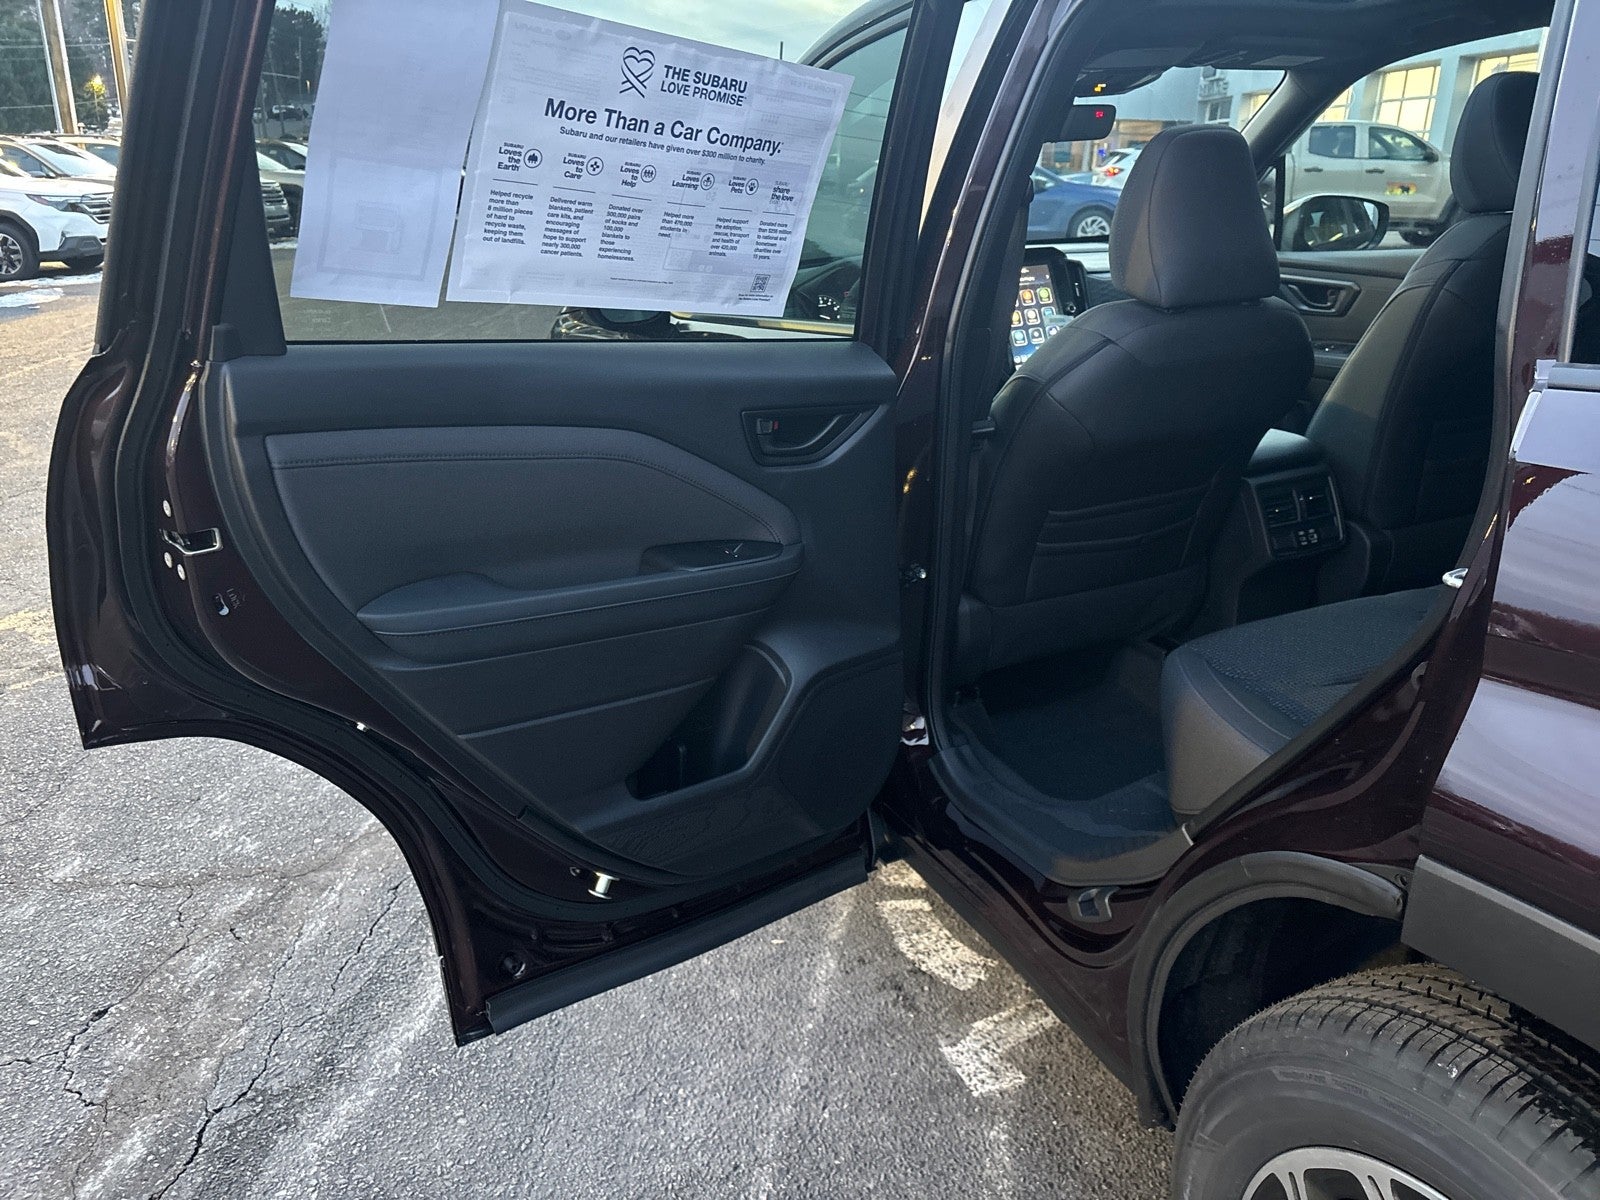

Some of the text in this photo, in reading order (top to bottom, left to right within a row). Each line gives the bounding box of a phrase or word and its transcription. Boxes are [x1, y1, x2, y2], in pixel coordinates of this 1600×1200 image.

[664, 65, 748, 94] THE SUBARU
[660, 80, 690, 97] LOVE
[544, 98, 597, 124] More
[604, 108, 649, 134] Than
[654, 121, 665, 135] a
[670, 120, 701, 142] Car
[559, 126, 588, 140] Subaru
[589, 131, 603, 141] and
[605, 135, 618, 143] our
[619, 136, 647, 148] retailers
[648, 141, 665, 151] have
[666, 144, 685, 154] given
[686, 148, 701, 157] over
[702, 149, 717, 159] $300
[718, 152, 737, 161] million
[745, 155, 766, 165] charity.
[499, 147, 522, 157] Loves
[497, 162, 520, 171] Earth
[563, 157, 585, 167] Loves
[575, 166, 583, 174] to
[620, 166, 640, 175] Loves
[564, 171, 582, 180] Care
[682, 174, 700, 183] Loves
[621, 179, 637, 188] Help
[672, 180, 698, 191] Learning
[728, 180, 745, 188] Loves
[490, 189, 511, 198] Helped
[773, 186, 791, 194] share
[550, 196, 577, 205] Delivered
[493, 205, 513, 214] million
[514, 208, 533, 216] pieces
[574, 207, 594, 215] patient
[608, 204, 632, 213] Donated
[485, 221, 506, 229] recycle
[545, 219, 580, 228] encouraging
[484, 228, 523, 237] keeping them
[544, 227, 572, 235] messages
[565, 236, 586, 244] support
[601, 232, 624, 240] blankets
[541, 241, 559, 249] nearly
[599, 247, 632, 255] experiencing
